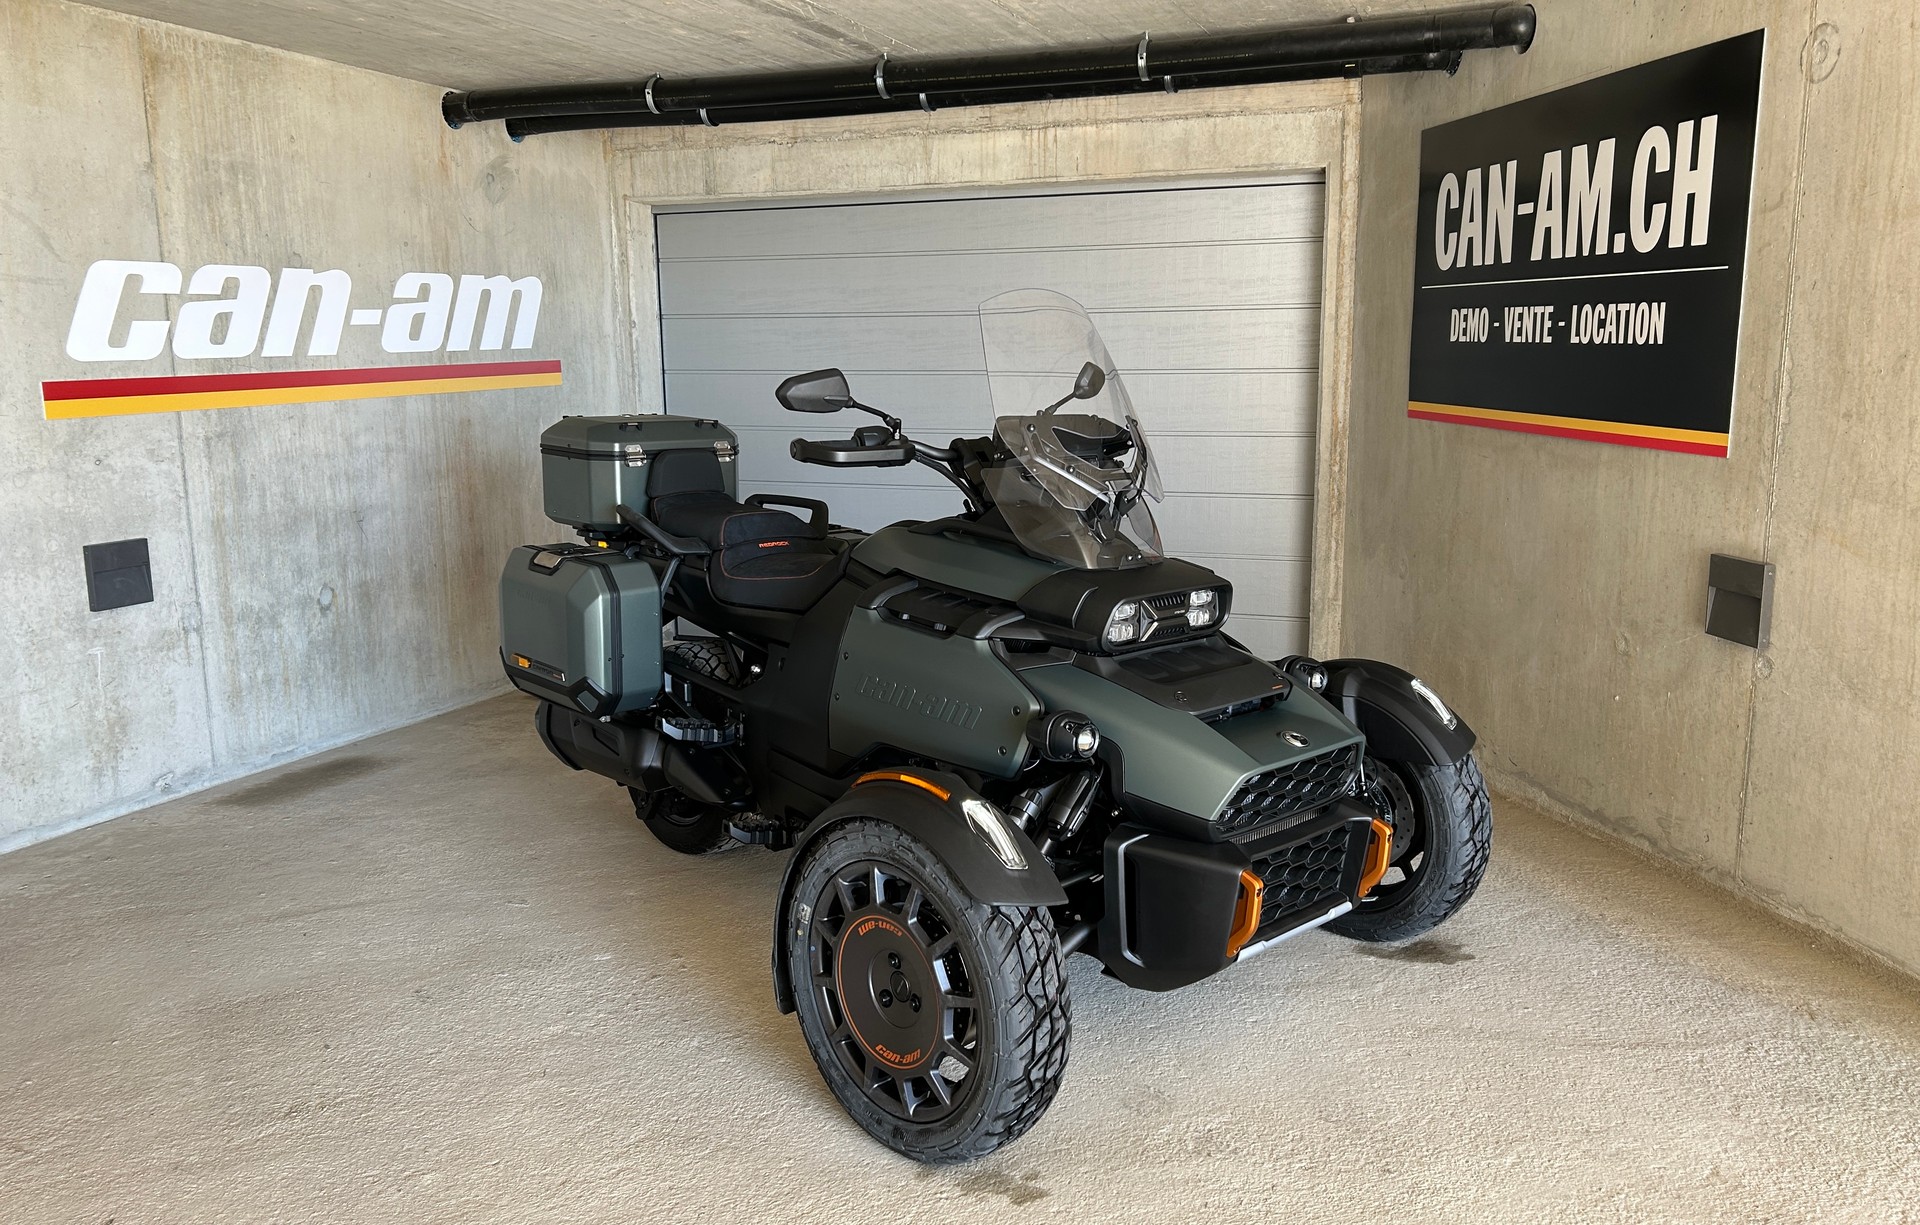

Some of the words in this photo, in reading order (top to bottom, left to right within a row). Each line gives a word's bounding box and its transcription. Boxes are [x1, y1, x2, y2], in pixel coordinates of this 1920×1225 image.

[1435, 114, 1719, 271] CAN-AM.CH
[65, 259, 543, 362] can-am
[1449, 306, 1490, 343] DEMO
[1504, 305, 1554, 344] VENTE
[1570, 301, 1667, 345] LOCATION
[875, 1044, 921, 1064] can-am
